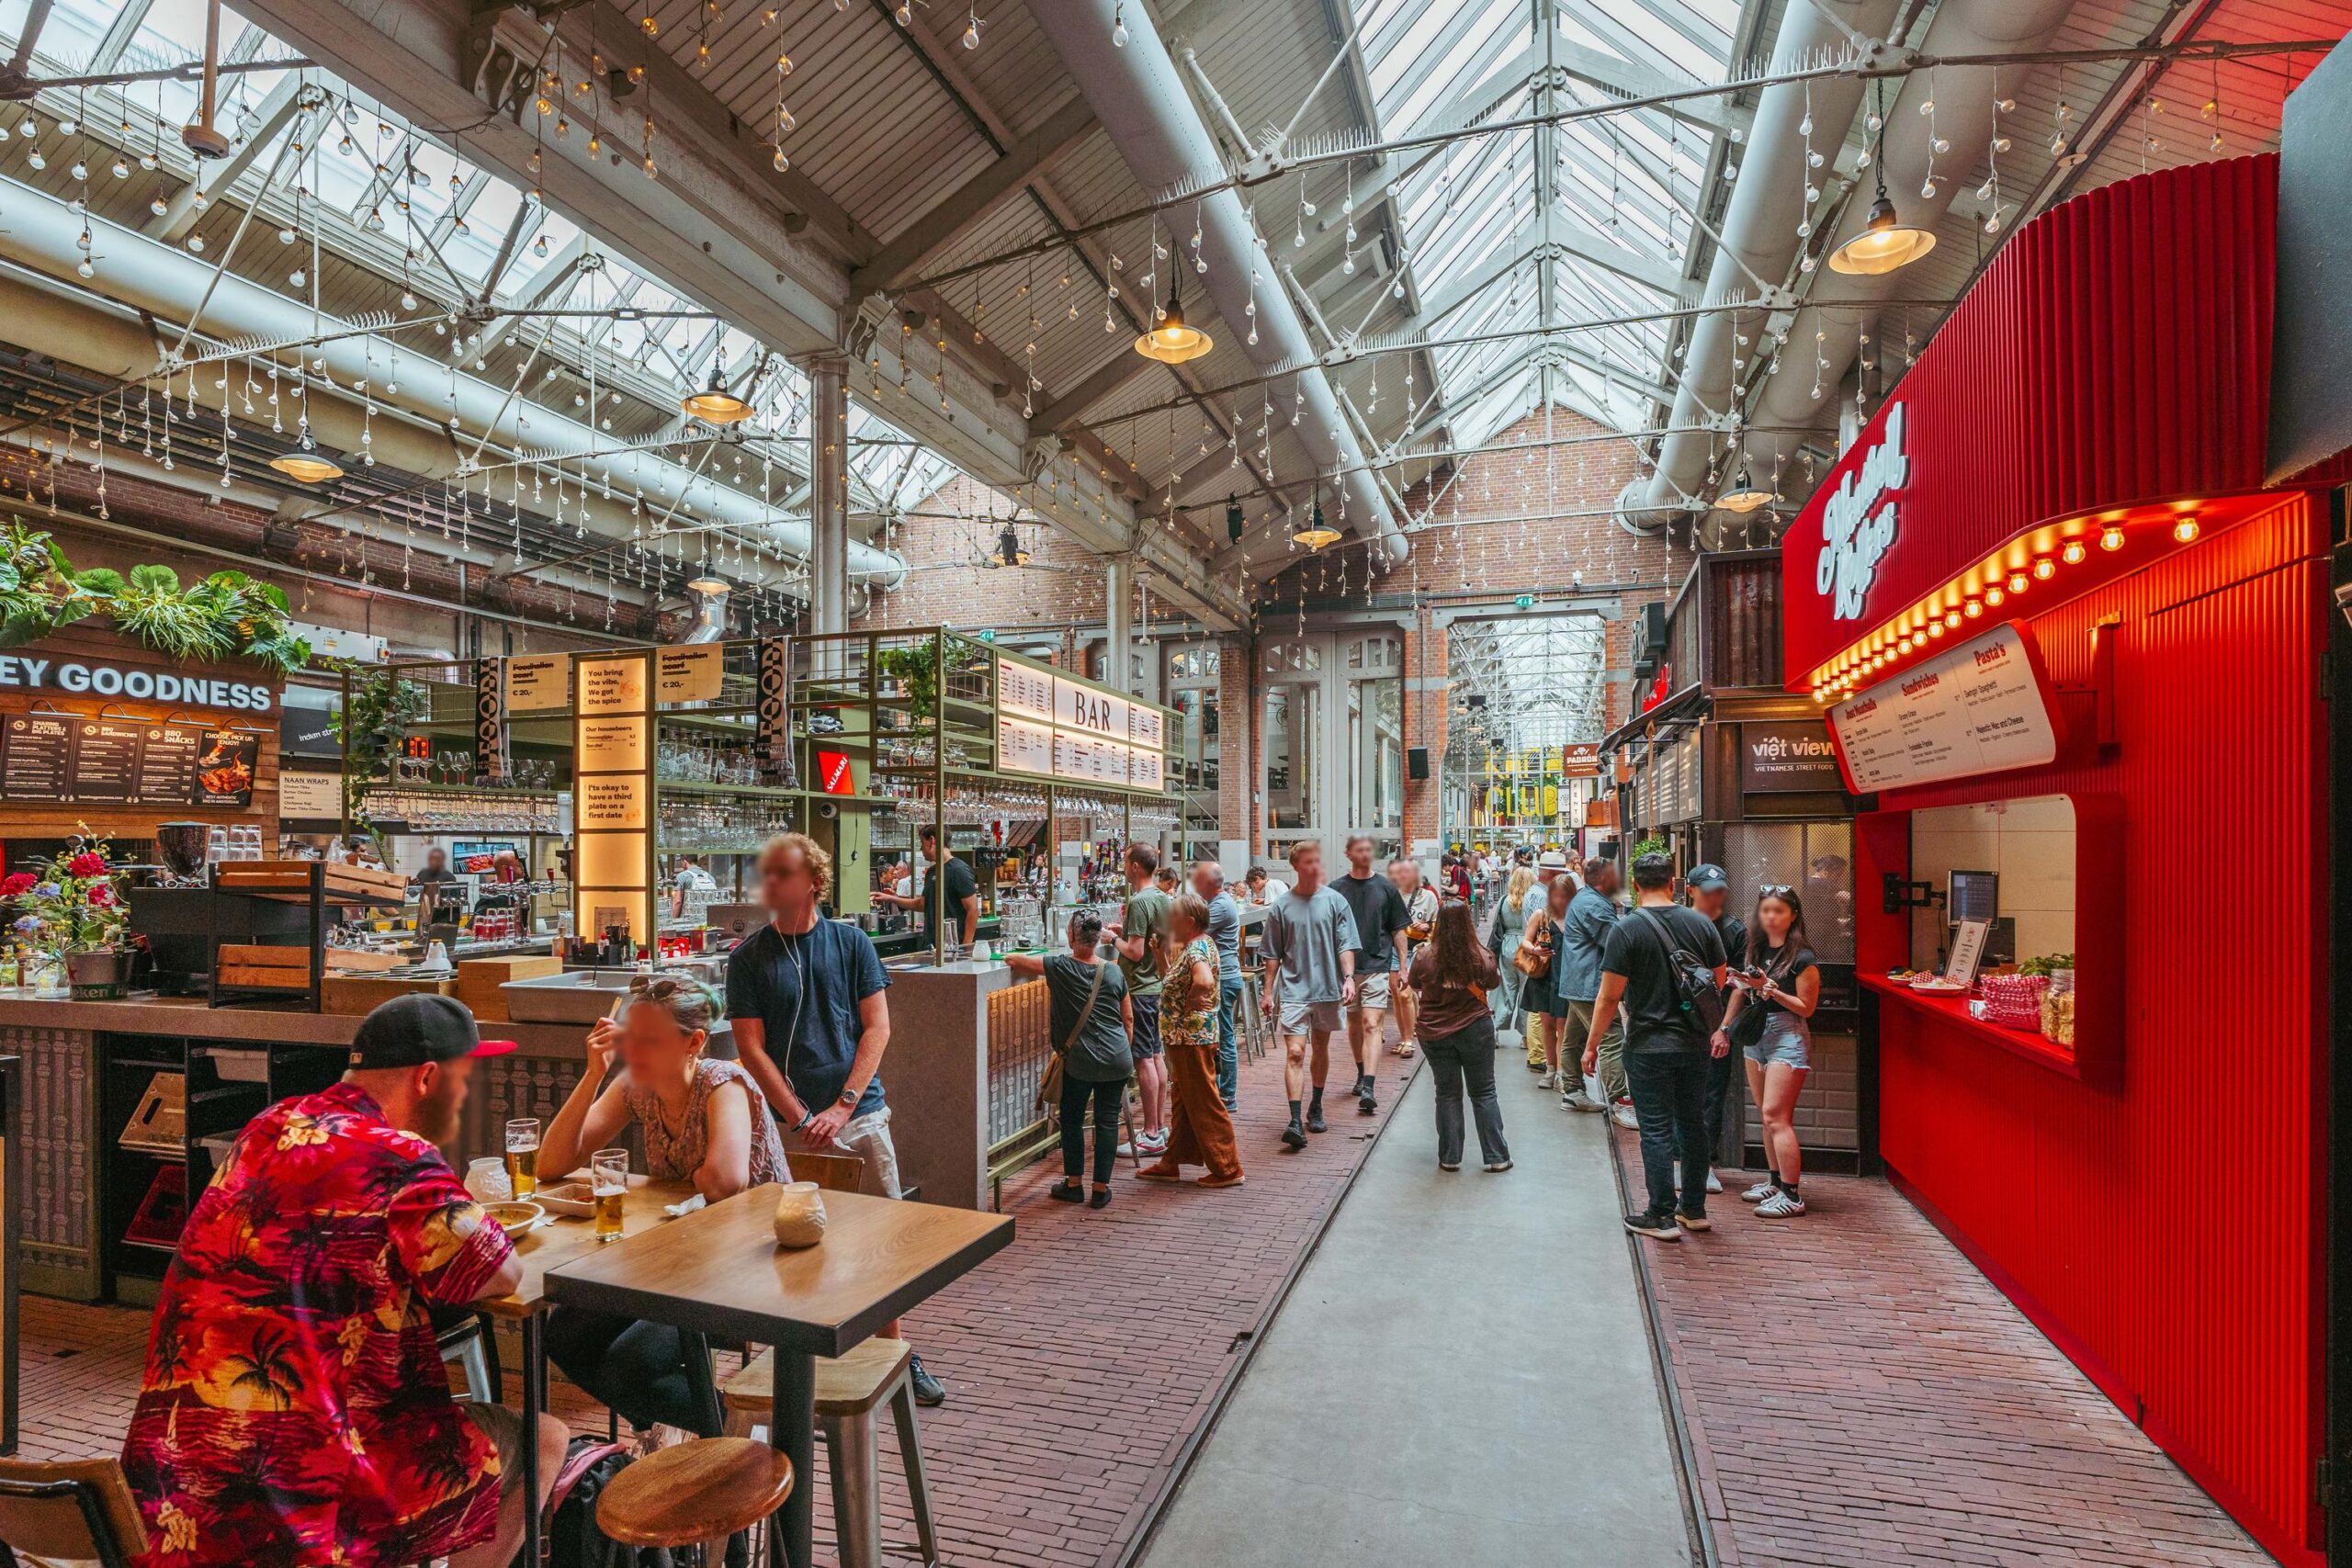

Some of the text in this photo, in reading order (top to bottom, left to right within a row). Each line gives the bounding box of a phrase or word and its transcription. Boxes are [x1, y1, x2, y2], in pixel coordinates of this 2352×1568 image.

[662, 652, 708, 662] Foodhallen
[1973, 642, 2007, 667] Pasta's
[513, 662, 554, 671] Foodhallen
[604, 669, 624, 677] bring
[59, 663, 272, 711] GOODNESS
[1901, 673, 1939, 696] Sandwiches
[602, 697, 621, 705] spice
[1075, 691, 1111, 732] BAR
[598, 725, 632, 733] housebeers
[164, 737, 196, 745] SNACKS
[299, 731, 321, 742] indian
[1751, 736, 1788, 761] việt
[1566, 753, 1598, 764] PADRÓN
[827, 756, 848, 792] SALMARI
[284, 776, 305, 784] NAAN
[601, 784, 619, 792] okay
[1485, 785, 1558, 818] CLUB
